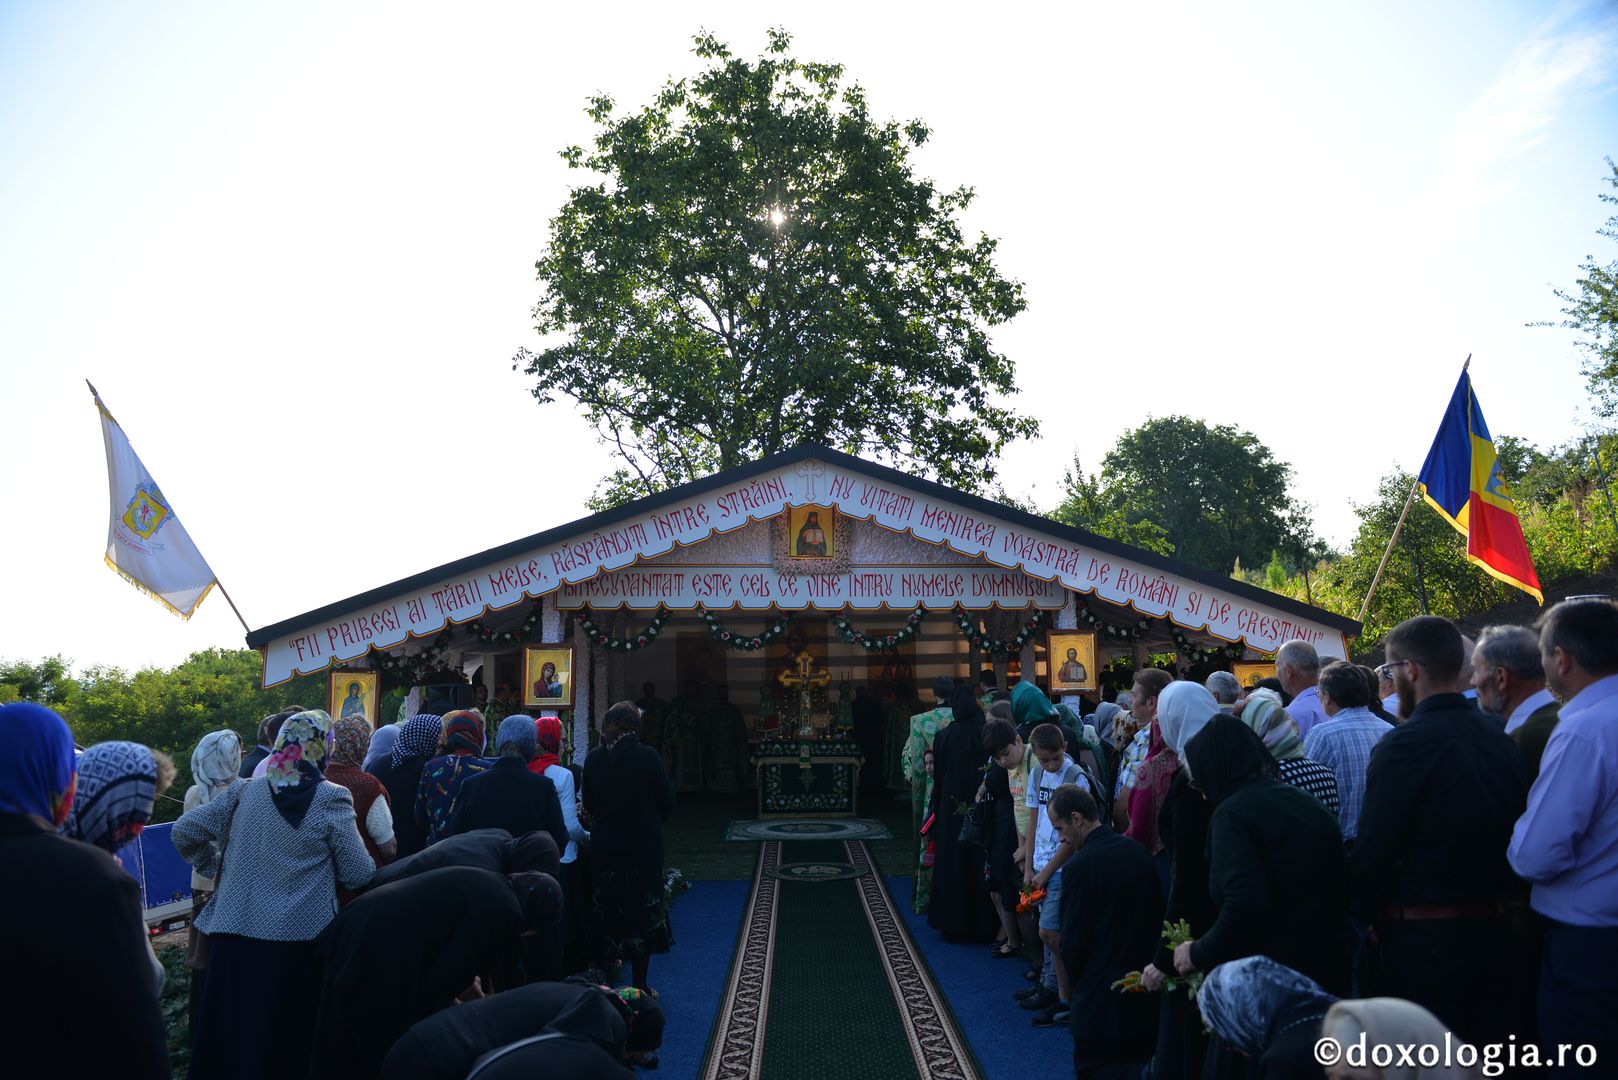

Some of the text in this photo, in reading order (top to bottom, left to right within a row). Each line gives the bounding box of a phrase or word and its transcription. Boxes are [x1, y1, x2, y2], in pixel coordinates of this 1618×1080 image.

[326, 606, 400, 651] PRIBEGI
[407, 597, 427, 624] AI
[488, 559, 548, 597] MELE,
[650, 503, 710, 541] ÎNTRE
[716, 475, 793, 519] STRĂINI,
[691, 573, 733, 597] ESTE
[740, 573, 770, 597] CEL
[777, 573, 798, 597] CE
[806, 574, 841, 597] VINE
[901, 573, 964, 597] NUMELE
[829, 474, 856, 500] NU
[920, 503, 996, 548] MENIREA
[1086, 558, 1110, 585] DE
[1115, 567, 1179, 608] ROMÂNI
[1207, 597, 1231, 624] DE
